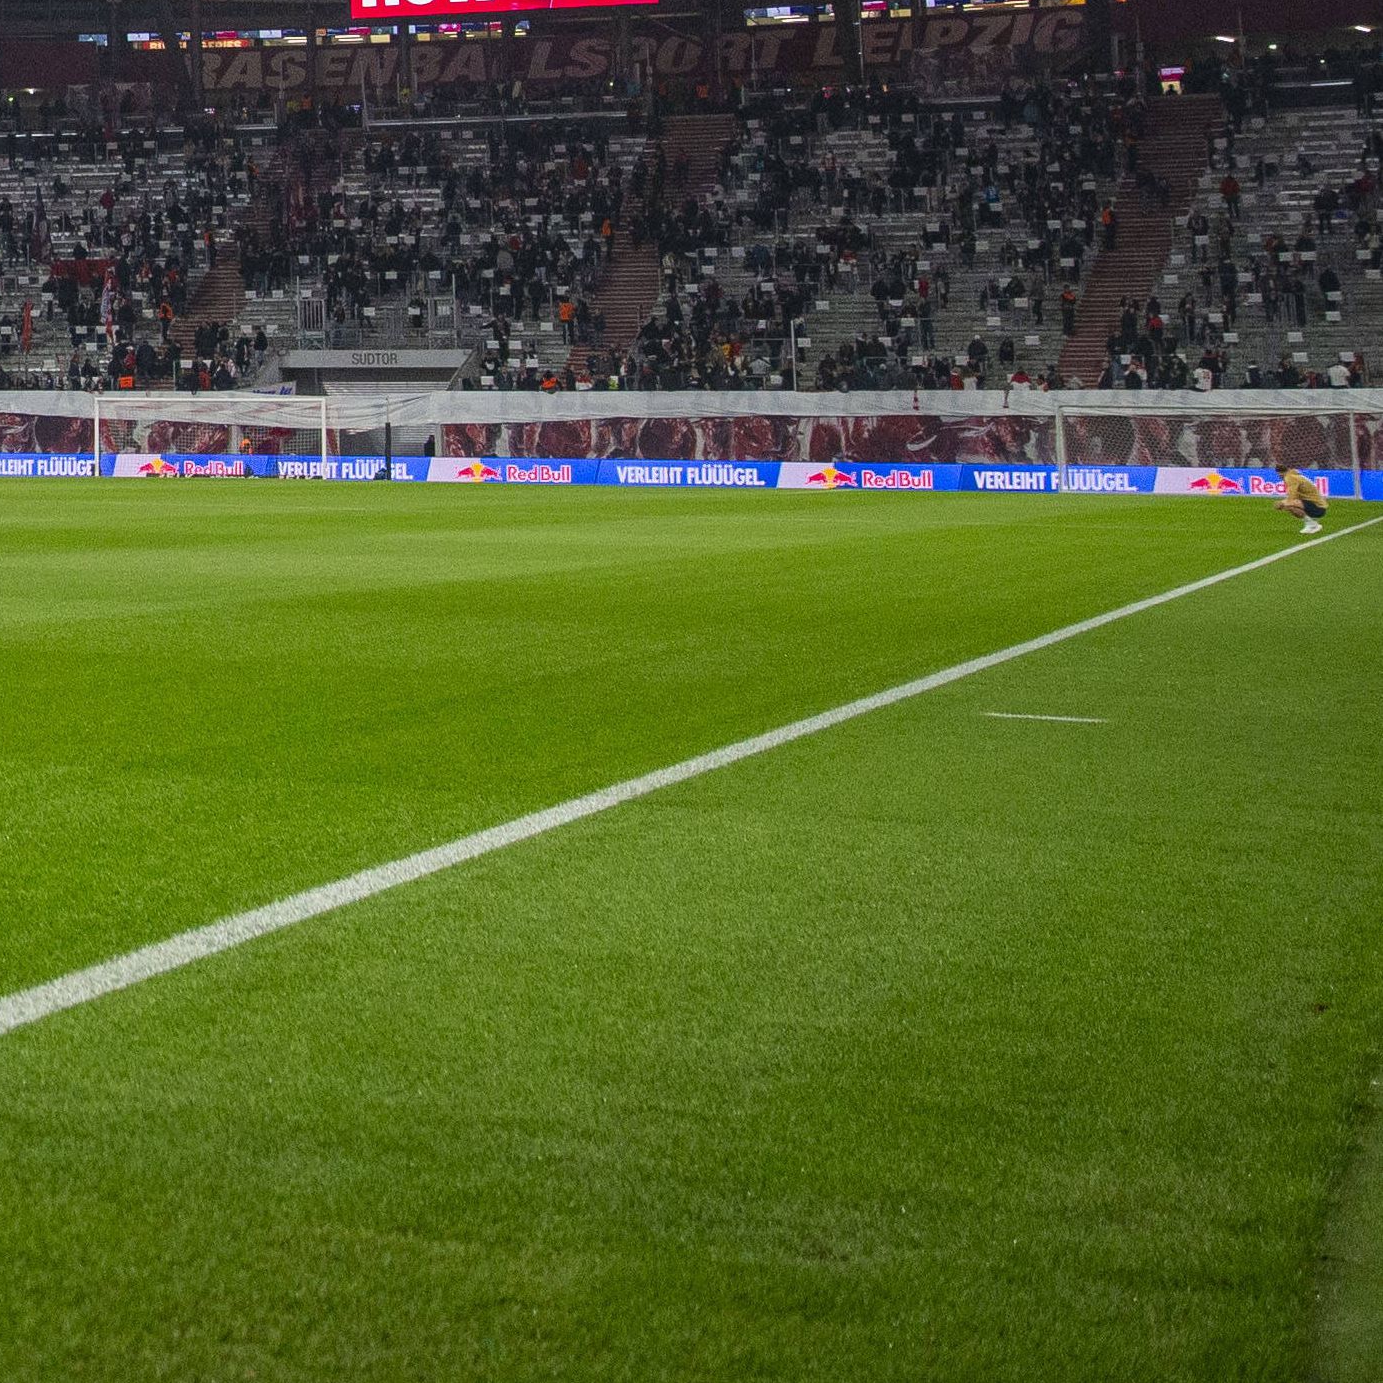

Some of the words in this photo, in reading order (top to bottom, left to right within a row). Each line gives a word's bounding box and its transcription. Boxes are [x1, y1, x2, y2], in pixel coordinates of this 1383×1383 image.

[184, 460, 213, 475] Red
[214, 460, 244, 475] Bull
[506, 465, 538, 482] Red
[539, 465, 572, 483] Bull
[617, 466, 683, 484] VERLEIHT
[861, 471, 898, 489] Red
[898, 470, 934, 489] Bull
[974, 471, 1046, 490] VERLEIHT
